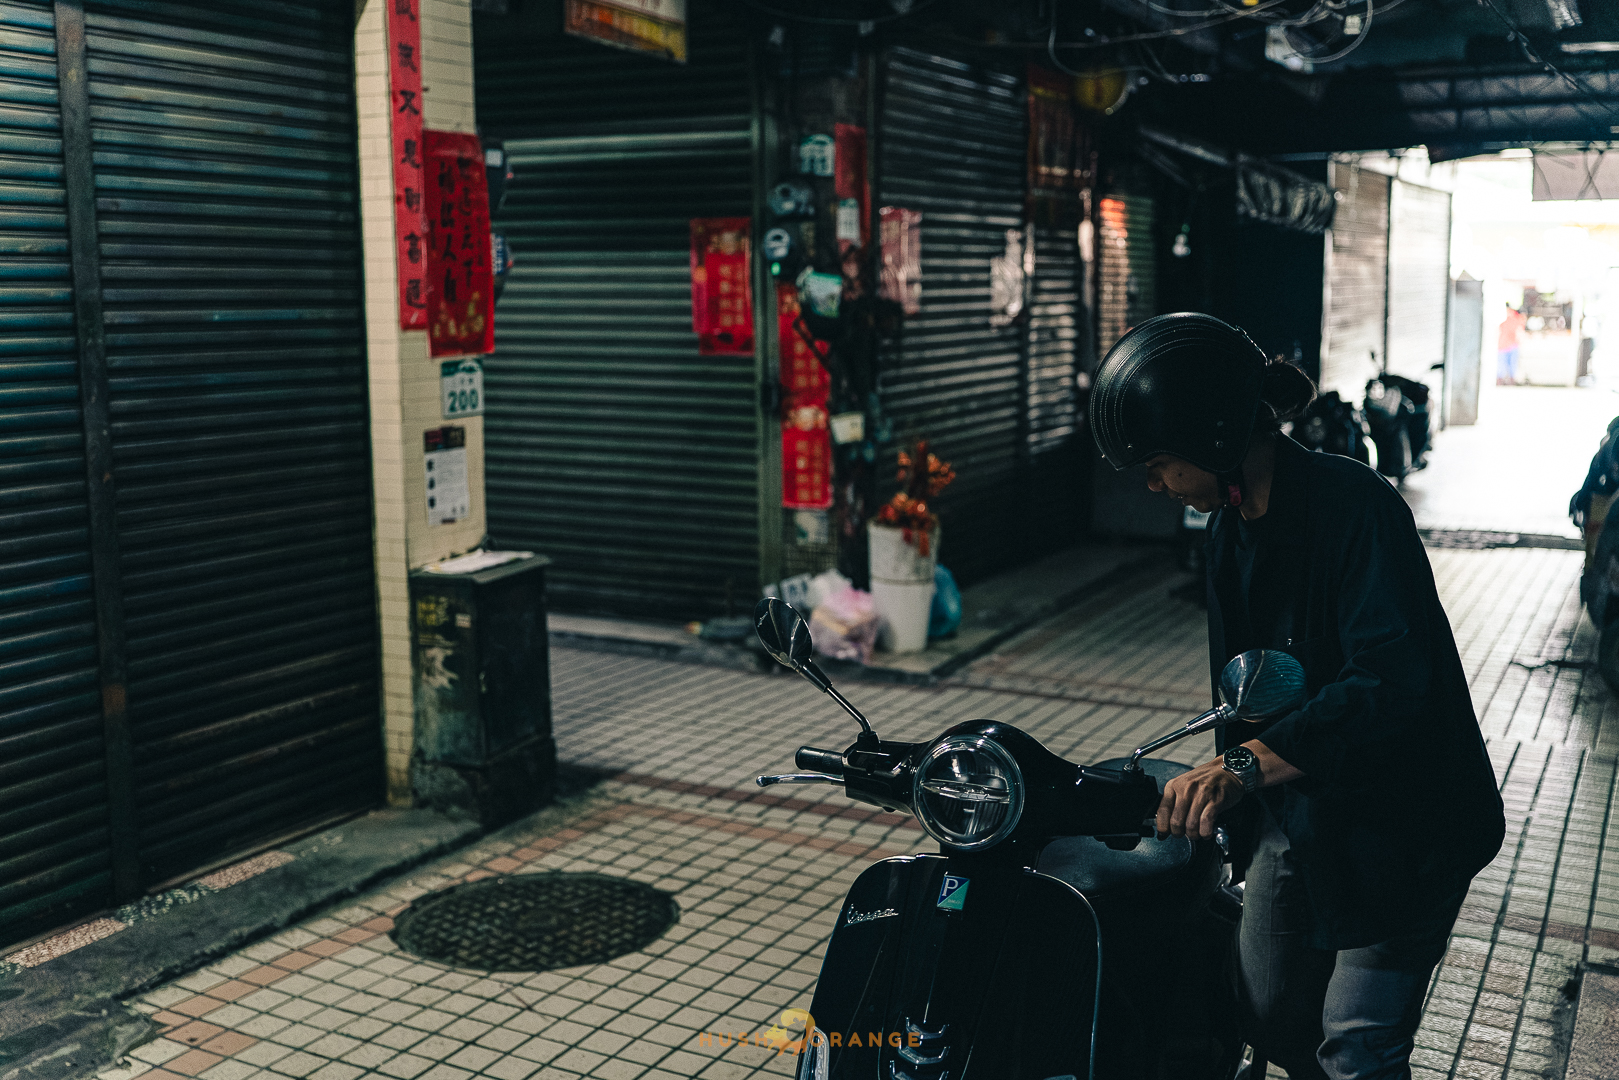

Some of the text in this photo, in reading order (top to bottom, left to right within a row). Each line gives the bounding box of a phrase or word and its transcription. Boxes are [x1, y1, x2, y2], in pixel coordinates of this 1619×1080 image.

[448, 389, 479, 413] 200
[942, 877, 959, 897] P
[844, 903, 900, 928] Vespa
